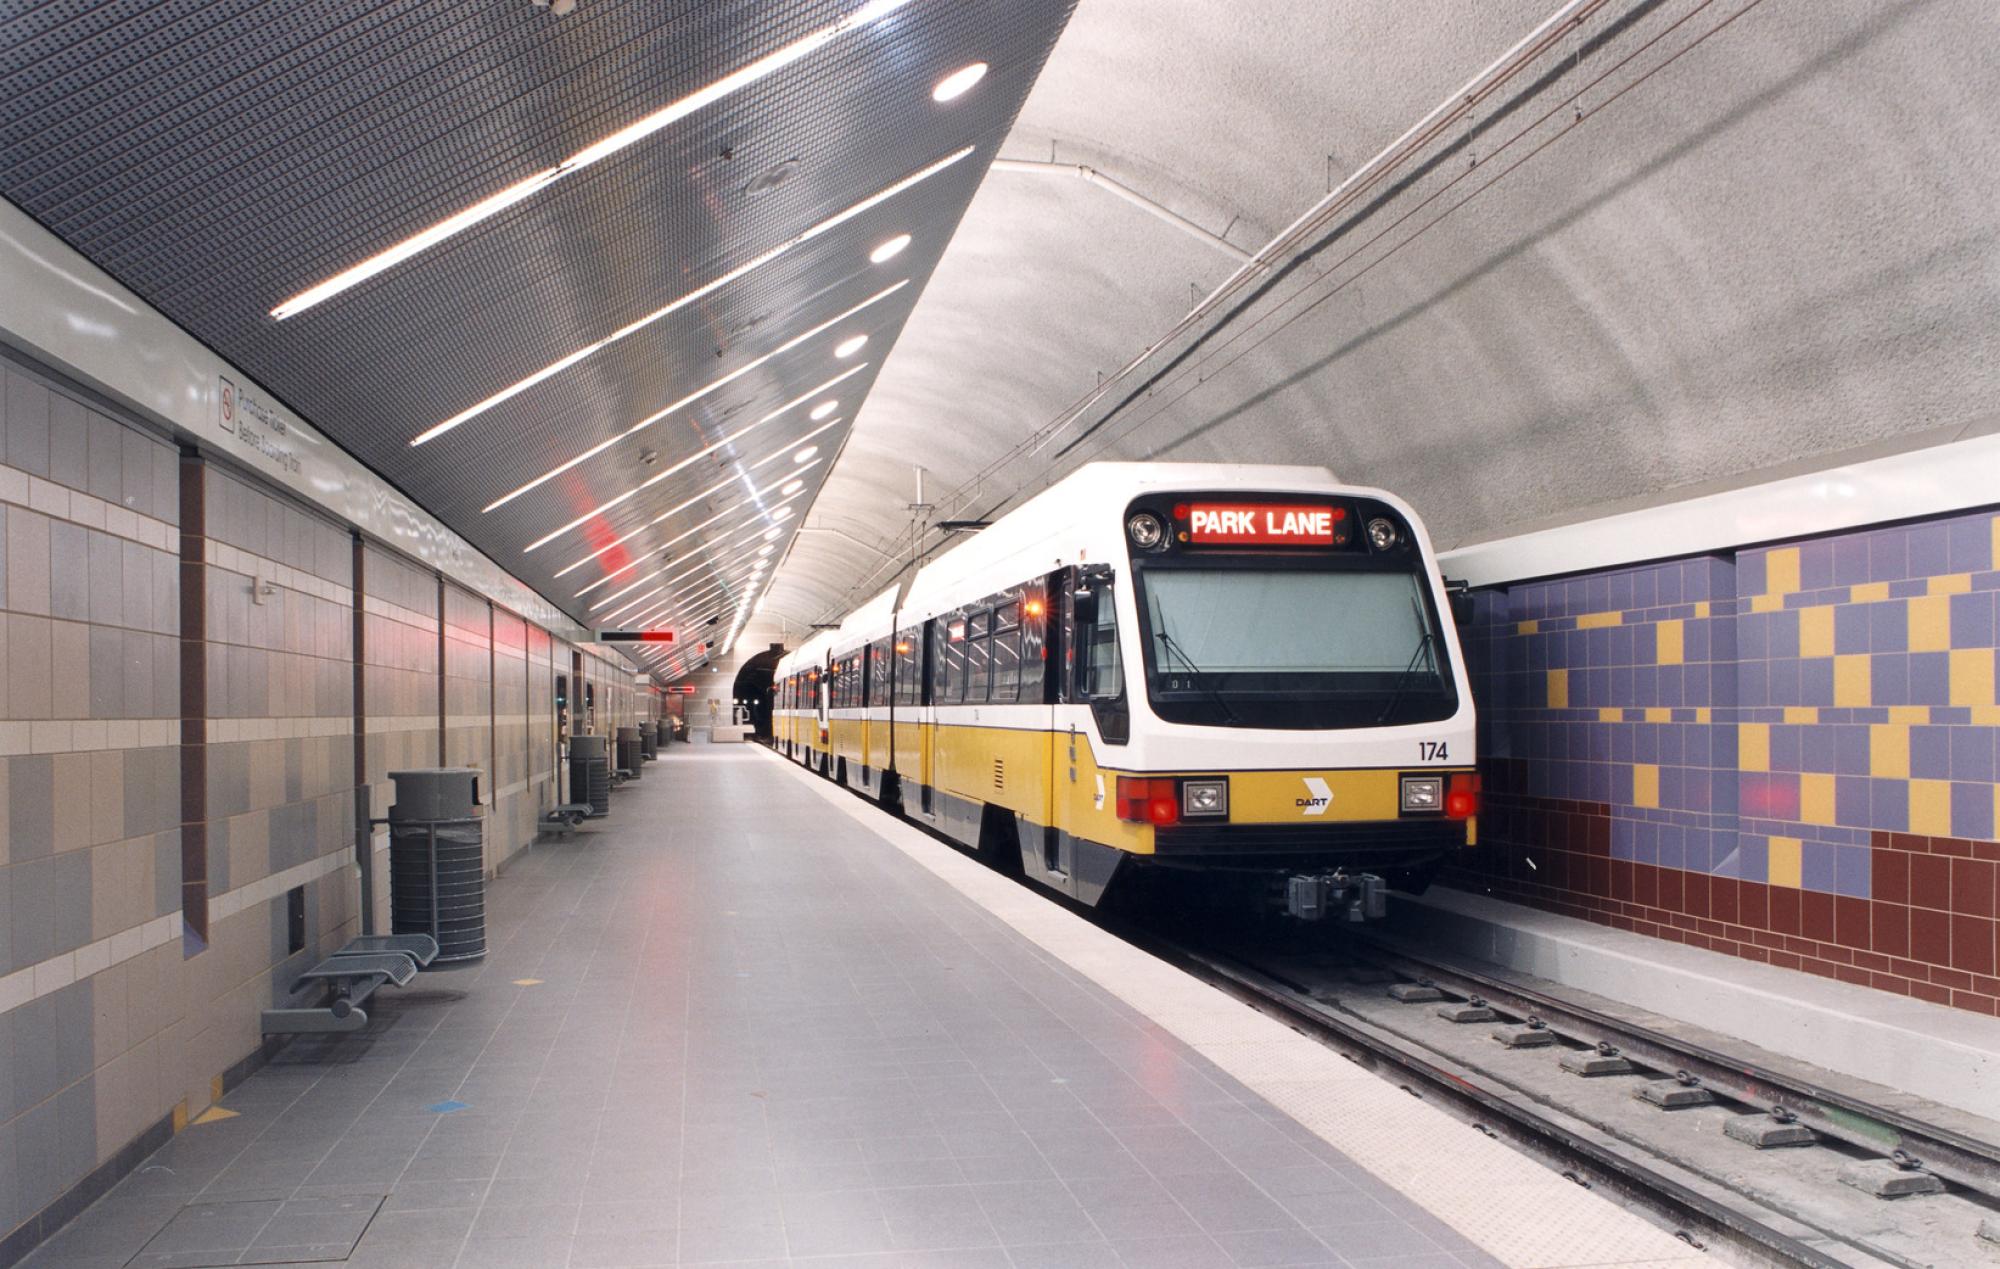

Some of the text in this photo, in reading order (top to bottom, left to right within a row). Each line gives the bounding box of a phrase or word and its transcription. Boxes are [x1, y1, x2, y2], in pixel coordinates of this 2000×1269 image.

[1191, 510, 1332, 536] PARK LANE
[1418, 741, 1448, 761] 174
[1295, 797, 1328, 807] DART
